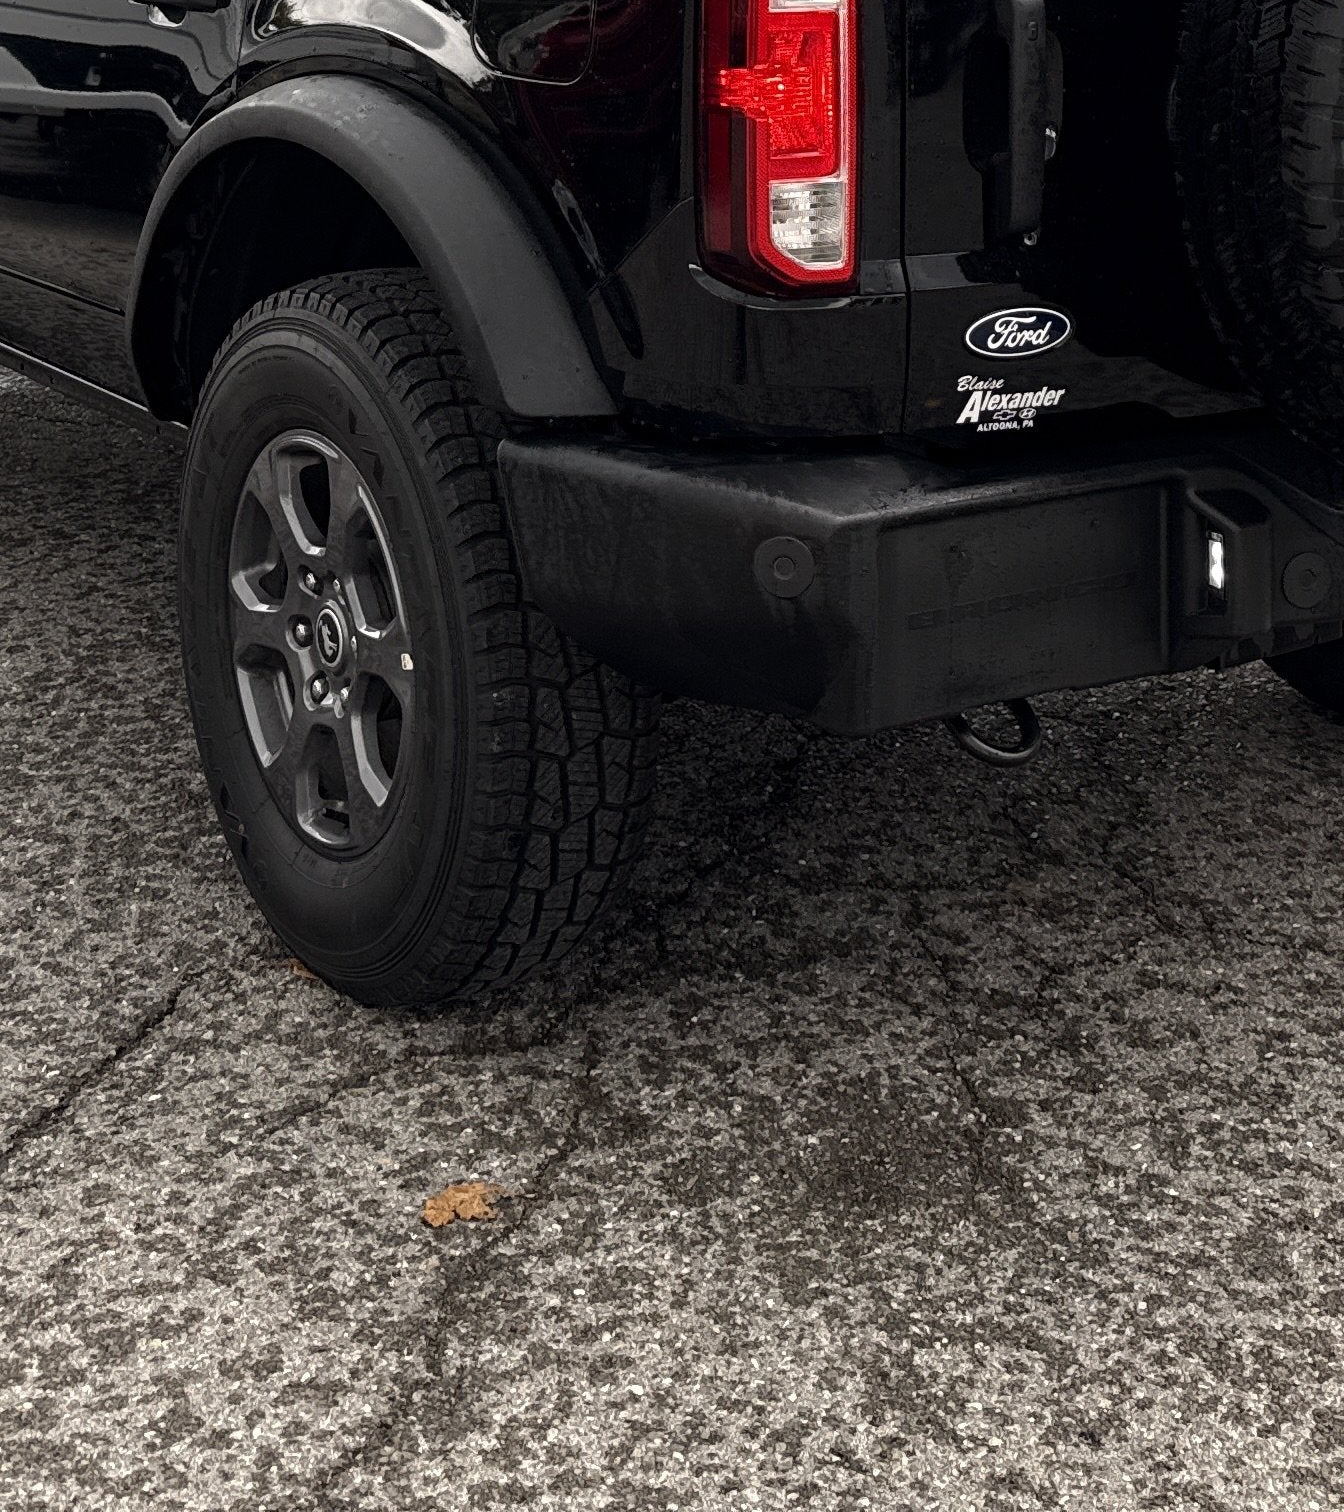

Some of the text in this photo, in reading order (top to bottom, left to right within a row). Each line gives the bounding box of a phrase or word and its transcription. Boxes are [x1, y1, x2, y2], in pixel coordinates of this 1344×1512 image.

[987, 316, 1052, 349] Ford
[957, 375, 1005, 391] Blaise
[956, 386, 1066, 424] Alexander
[1022, 419, 1034, 428] PA
